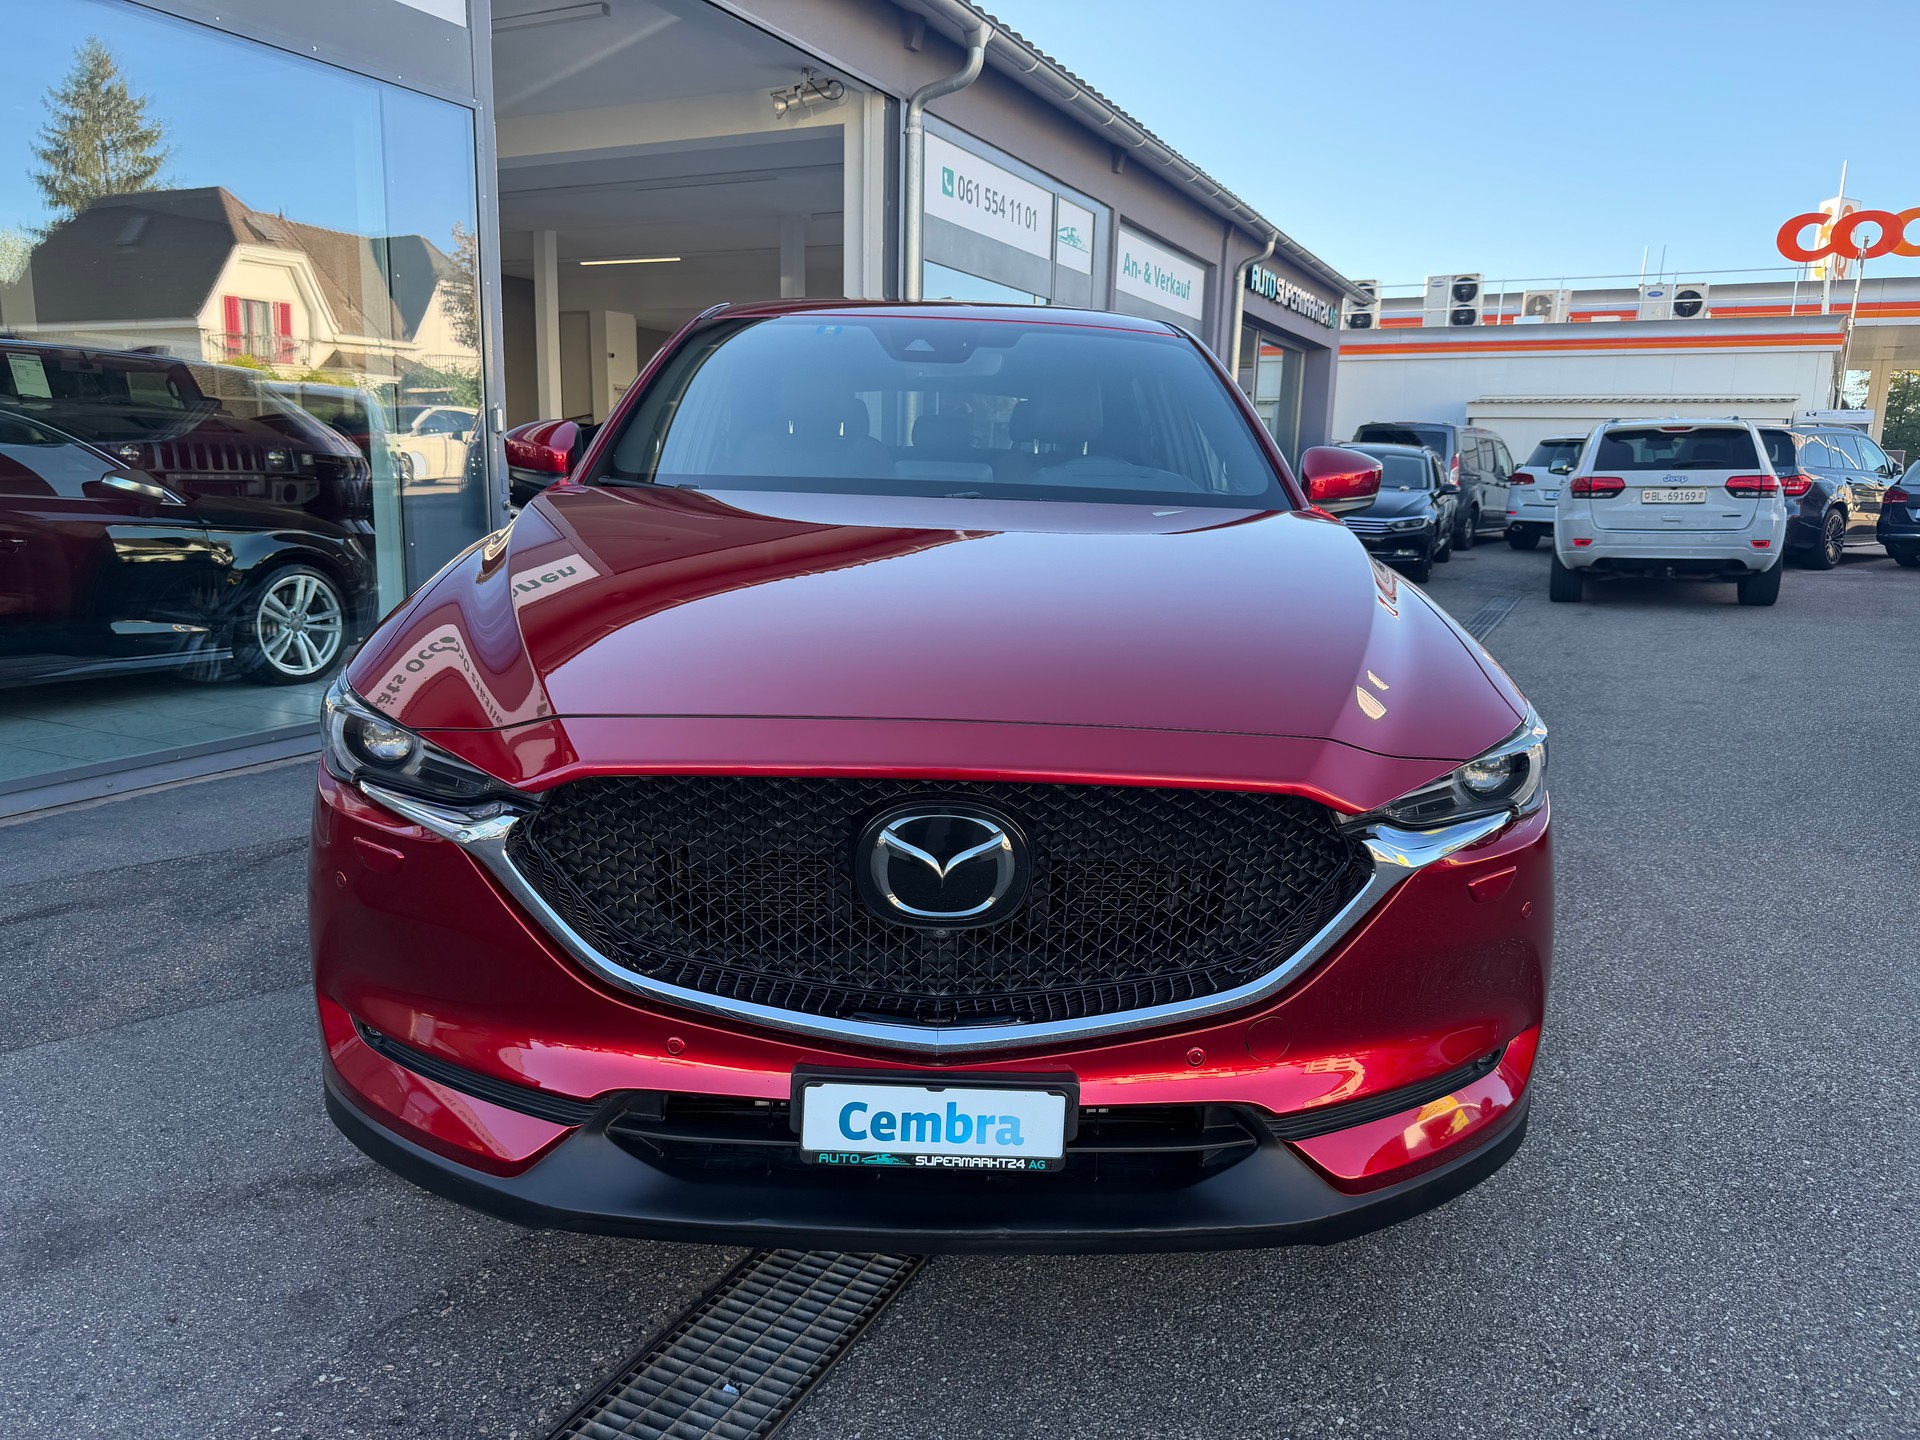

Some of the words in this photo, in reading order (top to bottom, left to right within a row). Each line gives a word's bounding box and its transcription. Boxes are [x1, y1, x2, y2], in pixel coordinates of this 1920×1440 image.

[958, 175, 980, 208] 061
[984, 187, 1006, 219] 554
[1009, 199, 1021, 226] 11
[1025, 206, 1037, 232] 01
[1123, 252, 1142, 279] An-
[1143, 262, 1152, 285] &
[1154, 265, 1191, 300] Verkauf
[1251, 263, 1277, 299] AUTO
[1663, 474, 1688, 483] Jeep
[838, 1101, 1025, 1146] Cembra
[818, 1153, 860, 1164] AUTO
[915, 1156, 1025, 1169] SUPERMARKT24
[1028, 1159, 1046, 1170] AG
